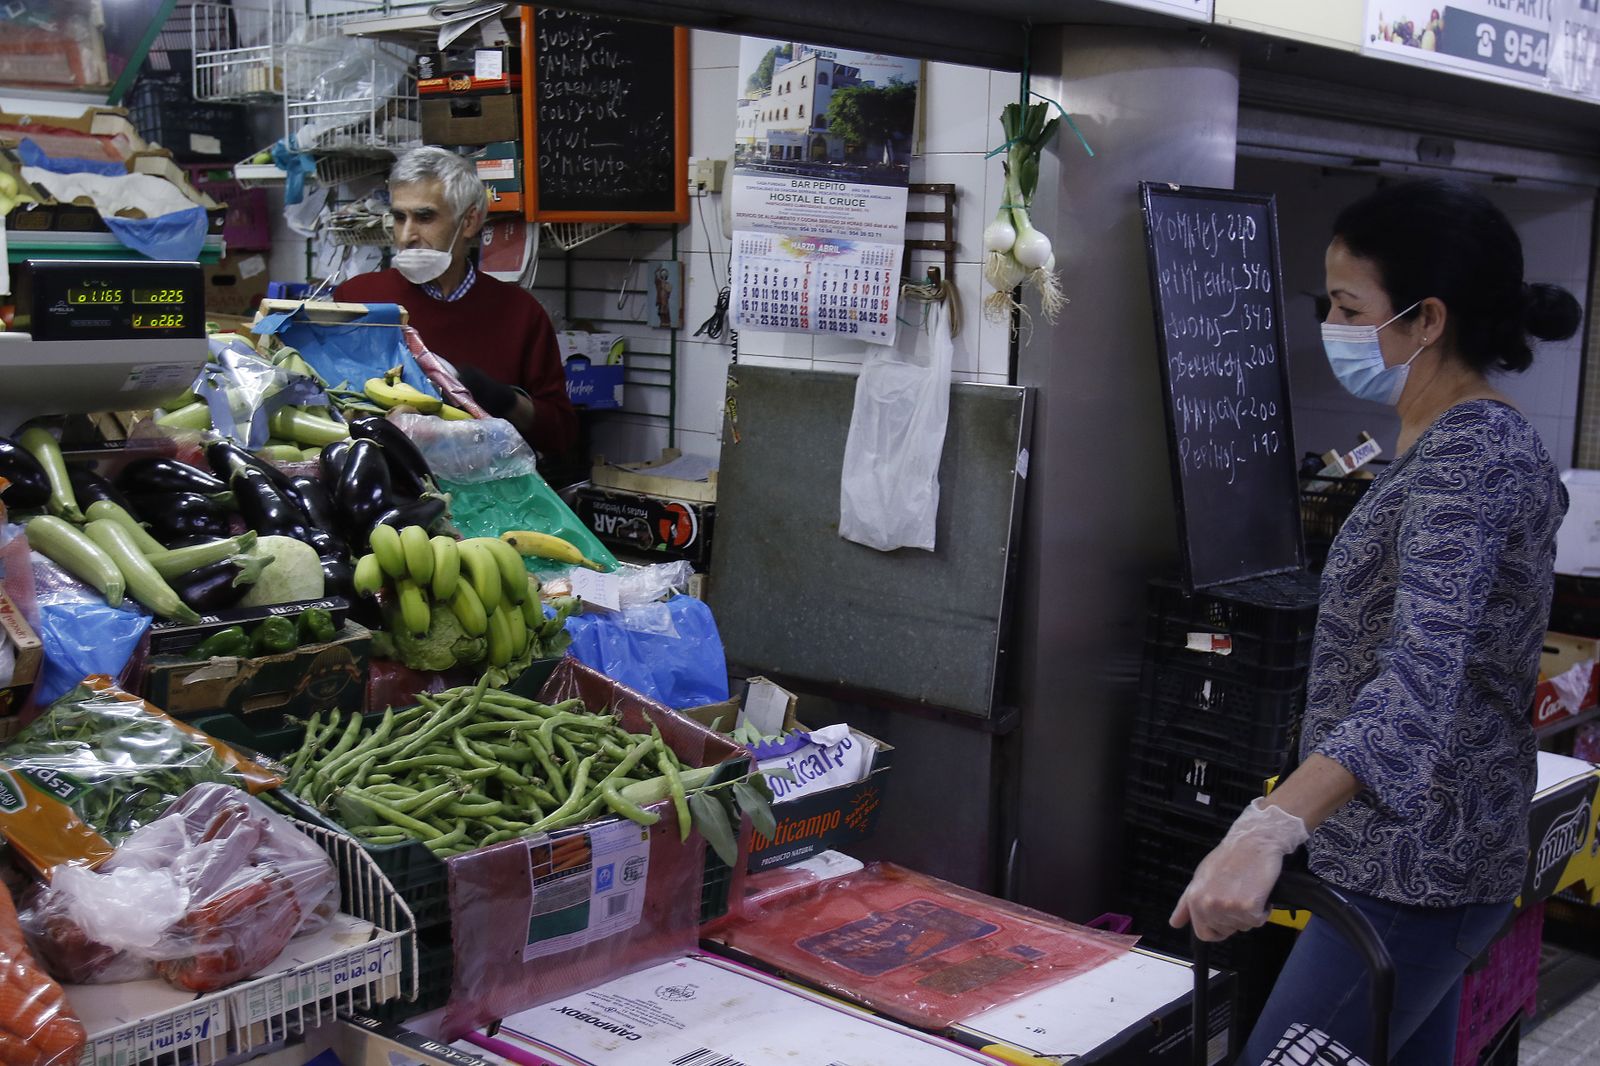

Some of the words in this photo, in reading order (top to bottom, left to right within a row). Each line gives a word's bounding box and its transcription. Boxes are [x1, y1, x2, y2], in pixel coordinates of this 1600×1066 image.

[1504, 30, 1547, 70] 954
[791, 180, 809, 188] BAR
[813, 181, 845, 190] PEPITO
[770, 192, 810, 202] HOSTAL
[813, 196, 825, 204] EL
[829, 197, 865, 207] CRUCE
[791, 242, 815, 250] MARZO
[818, 244, 840, 253] ABRIL
[752, 288, 759, 298] 10
[763, 289, 768, 299] 11
[772, 290, 778, 300] 12
[782, 291, 788, 301] 13
[791, 292, 798, 302] 14
[801, 293, 808, 303] 15
[863, 284, 869, 295] 10
[873, 285, 879, 295] 11
[883, 286, 890, 296] 12
[742, 300, 749, 310] 16
[752, 301, 758, 311] 17
[761, 302, 768, 312] 18
[771, 303, 778, 313] 19
[780, 304, 788, 314] 20
[790, 305, 797, 315] 21
[800, 306, 807, 316] 22
[820, 294, 827, 304] 13
[830, 295, 837, 305] 14
[840, 296, 847, 306] 15
[850, 297, 857, 307] 16
[861, 298, 867, 308] 17
[871, 299, 878, 309] 18
[881, 300, 888, 310] 19
[761, 315, 768, 325] 25
[770, 316, 778, 326] 26
[781, 317, 788, 326] 27
[791, 318, 799, 327] 28
[801, 318, 808, 328] 29
[819, 307, 827, 318] 20
[828, 308, 836, 318] 21
[839, 309, 847, 319] 22
[859, 311, 867, 321] 24
[869, 312, 877, 323] 25
[880, 314, 887, 323] 26
[819, 320, 827, 329] 27
[829, 321, 837, 331] 28
[839, 322, 847, 332] 29
[849, 323, 857, 333] 30
[1251, 343, 1275, 366] 200
[1251, 397, 1276, 421] 200
[627, 504, 649, 519] Frutas
[761, 851, 791, 866] PRODUCTO
[792, 845, 814, 858] NATURAL
